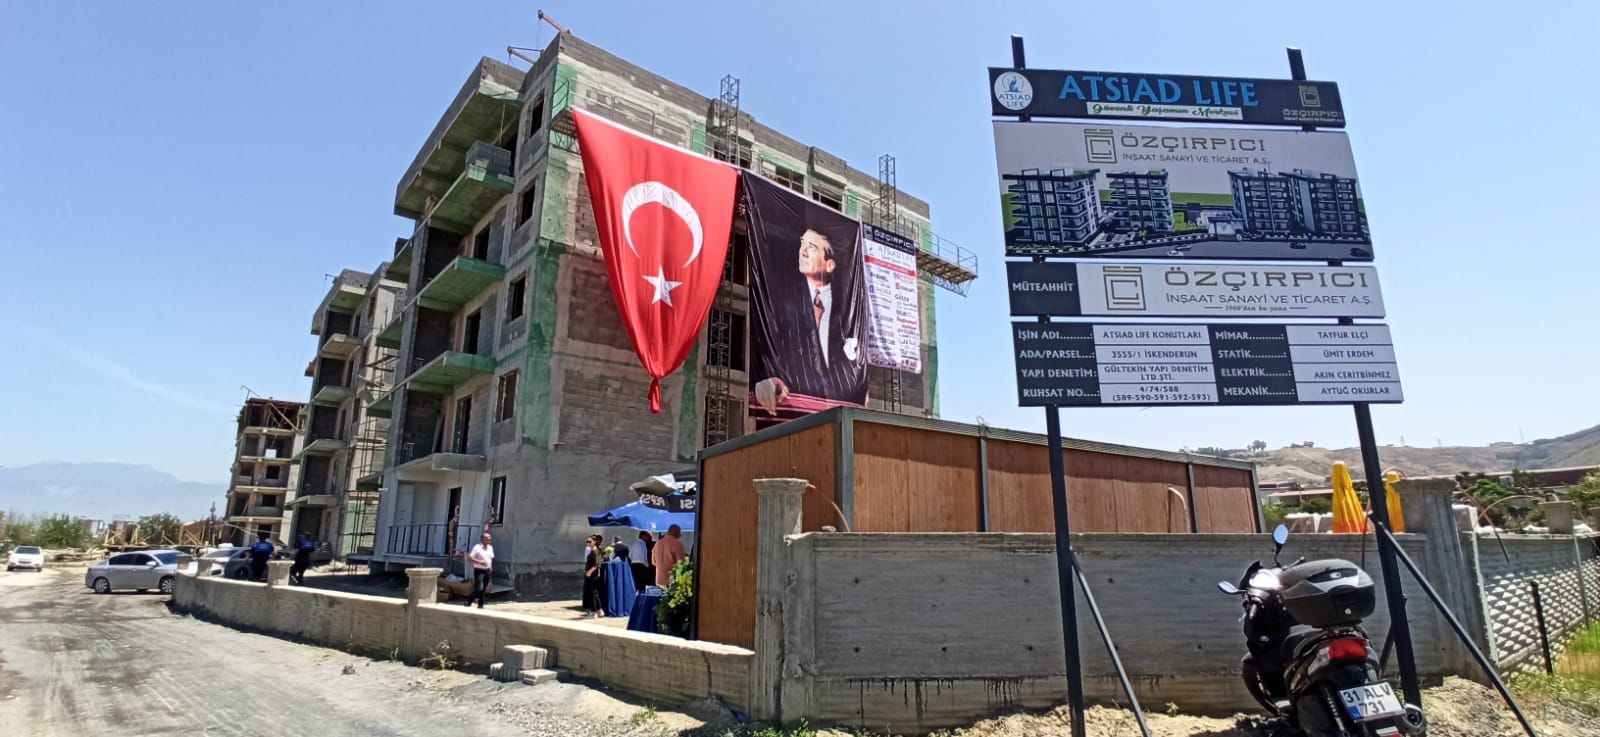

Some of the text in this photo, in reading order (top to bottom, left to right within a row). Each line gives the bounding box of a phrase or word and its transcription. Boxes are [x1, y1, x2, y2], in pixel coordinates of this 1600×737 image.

[1192, 79, 1259, 107] LIFE
[1006, 100, 1025, 108] LIFE
[1120, 132, 1267, 153] ÖZÇIRPICI
[1195, 155, 1209, 163] VE
[1164, 266, 1368, 292] ÖZÇIRPICI
[1012, 280, 1074, 292] MÜTEAHHİT
[1166, 292, 1215, 304] İNŞAAT
[1218, 293, 1267, 304] SANAYİ
[1271, 295, 1288, 304] VE
[1292, 293, 1346, 304] TİCARET
[1018, 329, 1039, 340] İŞİN
[1135, 331, 1150, 339] LIFE
[1152, 331, 1202, 339] KONUTLARI
[1317, 330, 1369, 340] TAYFUR ELÇİ
[1111, 349, 1198, 359] 3555/1 İSKENDERUN
[1322, 349, 1375, 358] ÜMİT ERDEM
[1020, 368, 1045, 378] YAPI
[1104, 364, 1209, 373] GÜLTEKİN YAPI DENETİM
[1314, 371, 1335, 379] AKIN
[1023, 388, 1064, 397] RUHSAT
[1351, 386, 1391, 395] OKURLAR
[1343, 684, 1391, 703] 31 ALV
[1358, 700, 1386, 714] 731
